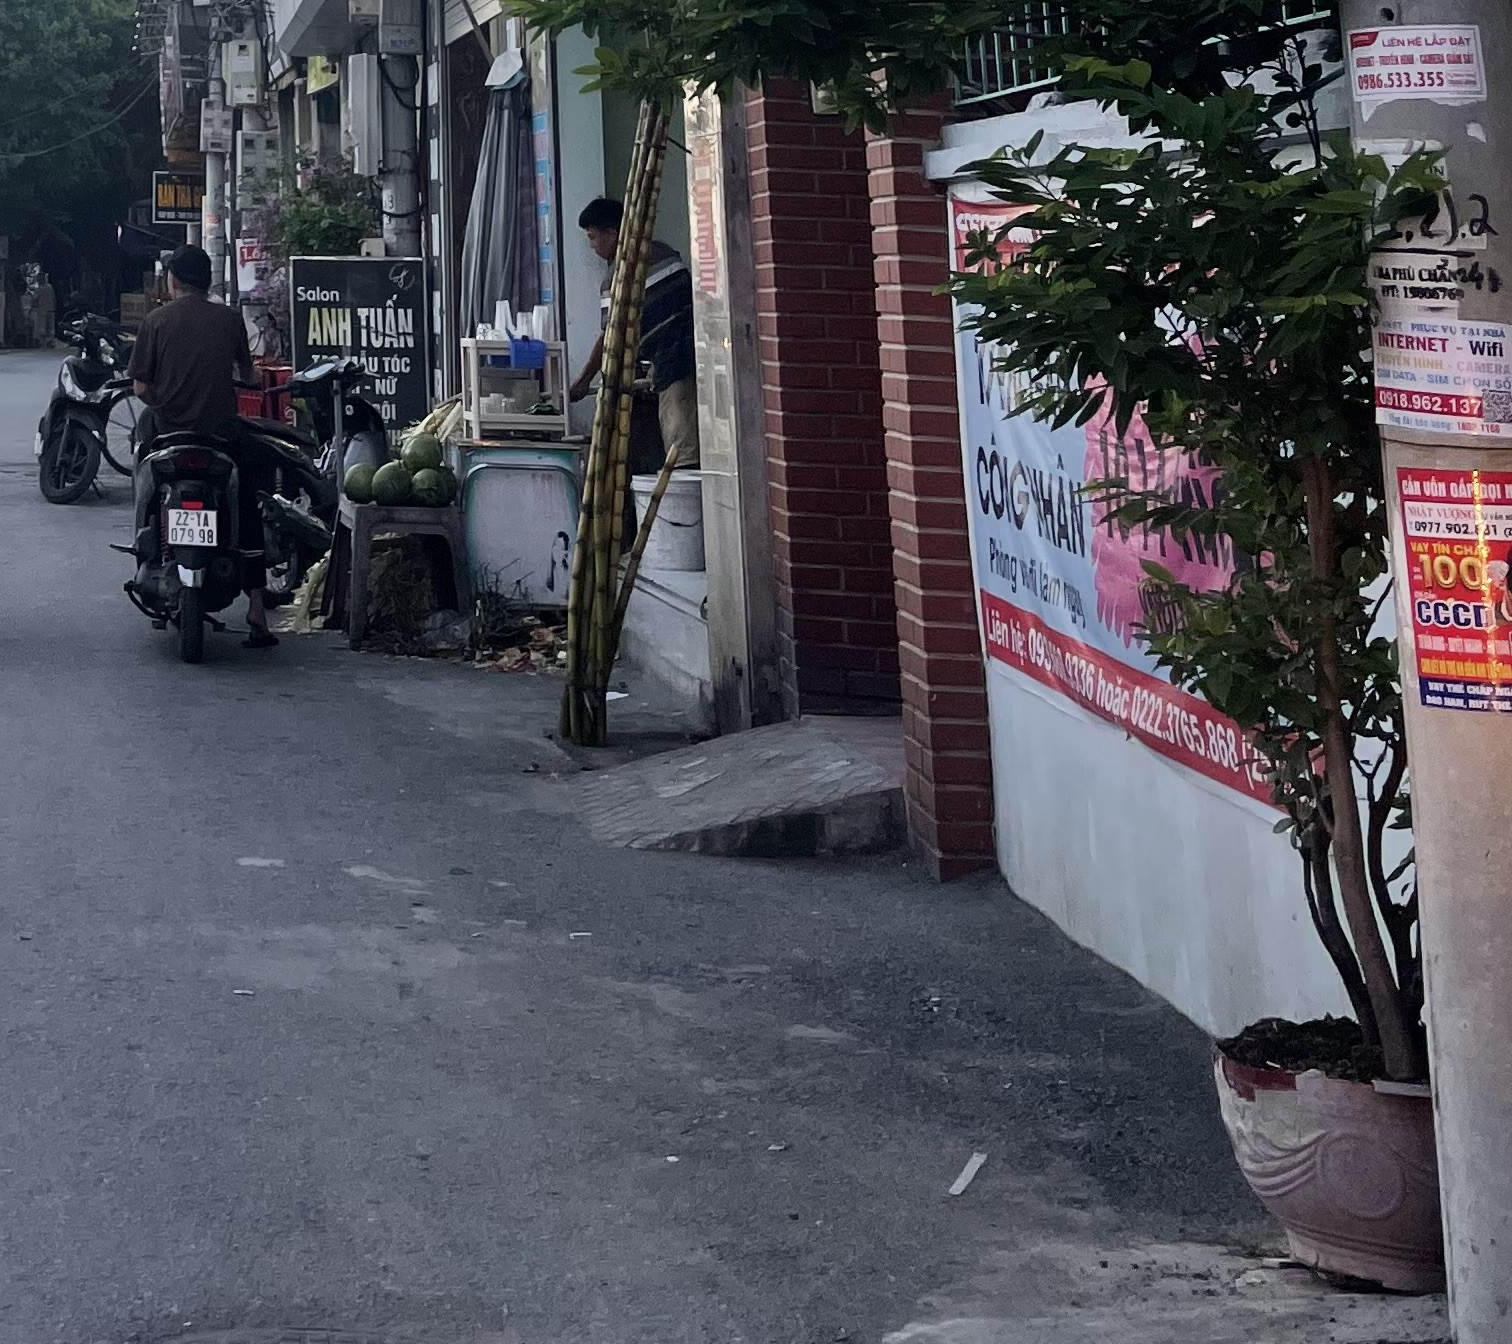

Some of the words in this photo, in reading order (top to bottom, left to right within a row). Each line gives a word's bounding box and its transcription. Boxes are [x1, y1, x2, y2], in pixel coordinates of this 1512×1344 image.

[1357, 71, 1445, 90] 0986.533.355
[296, 286, 340, 303] Salon
[307, 306, 353, 347] ANH
[356, 293, 415, 349] TUẤN
[1378, 331, 1449, 353] INTERNET
[1469, 339, 1504, 358] Wifi
[381, 352, 411, 374] TÓC
[374, 377, 399, 396] NỮ
[1378, 390, 1482, 416] 0918.962.137
[1410, 541, 1430, 554] VAY
[1432, 541, 1451, 555] TÍN
[1418, 553, 1484, 590] 100
[985, 606, 1010, 649] Liên
[1096, 666, 1130, 720] hoặc
[1130, 685, 1240, 774] 0222.3765.868
